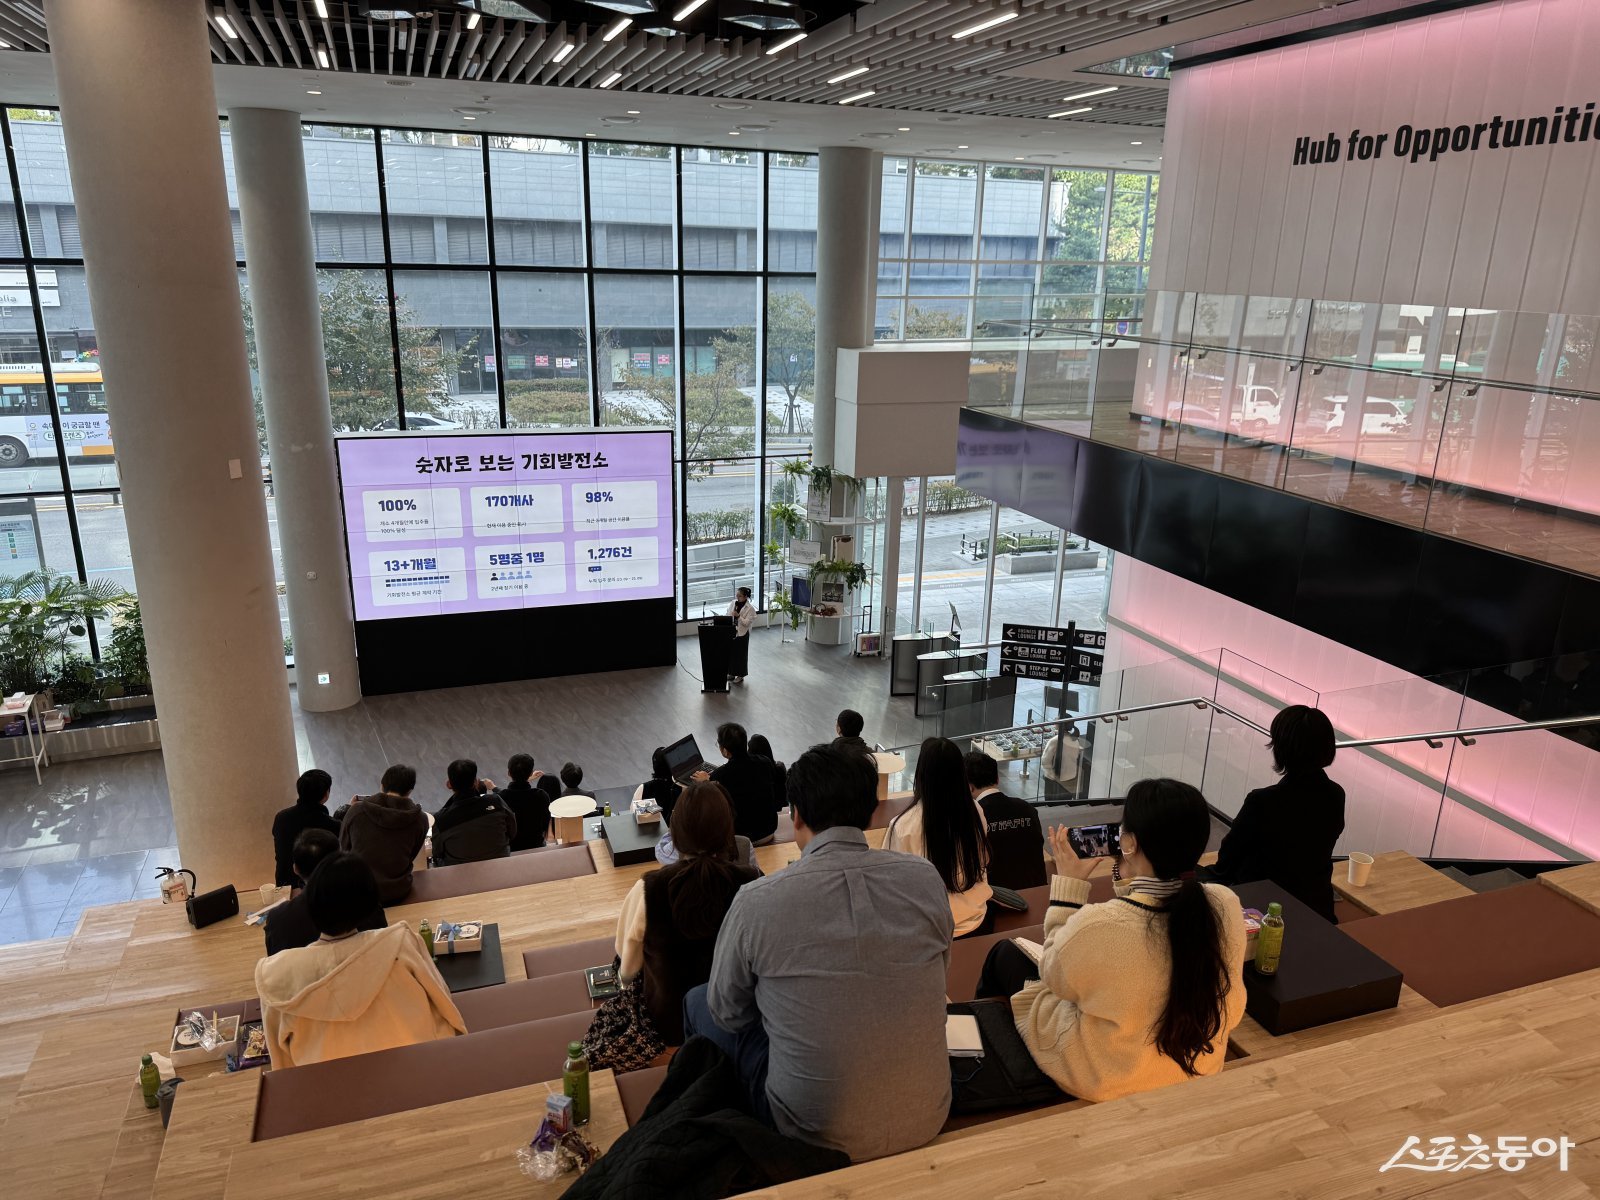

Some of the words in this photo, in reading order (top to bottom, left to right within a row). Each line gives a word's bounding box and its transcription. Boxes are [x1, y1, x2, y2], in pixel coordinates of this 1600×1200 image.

[1293, 132, 1341, 165] Hub
[1347, 129, 1388, 162] for
[1394, 102, 1600, 164] Opportuniti
[415, 455, 472, 474] 숫자로
[479, 454, 515, 472] 보는
[521, 451, 609, 471] 기회발전소
[485, 494, 534, 507] 170개사
[585, 491, 614, 503] 98%
[378, 499, 417, 512] 100%
[489, 552, 523, 565] 5명중
[526, 551, 545, 563] 1명
[587, 546, 633, 560] 1,276건
[384, 558, 437, 571] 13+개월
[1037, 629, 1046, 641] H
[1096, 635, 1106, 646] G
[1030, 647, 1048, 655] FLOW
